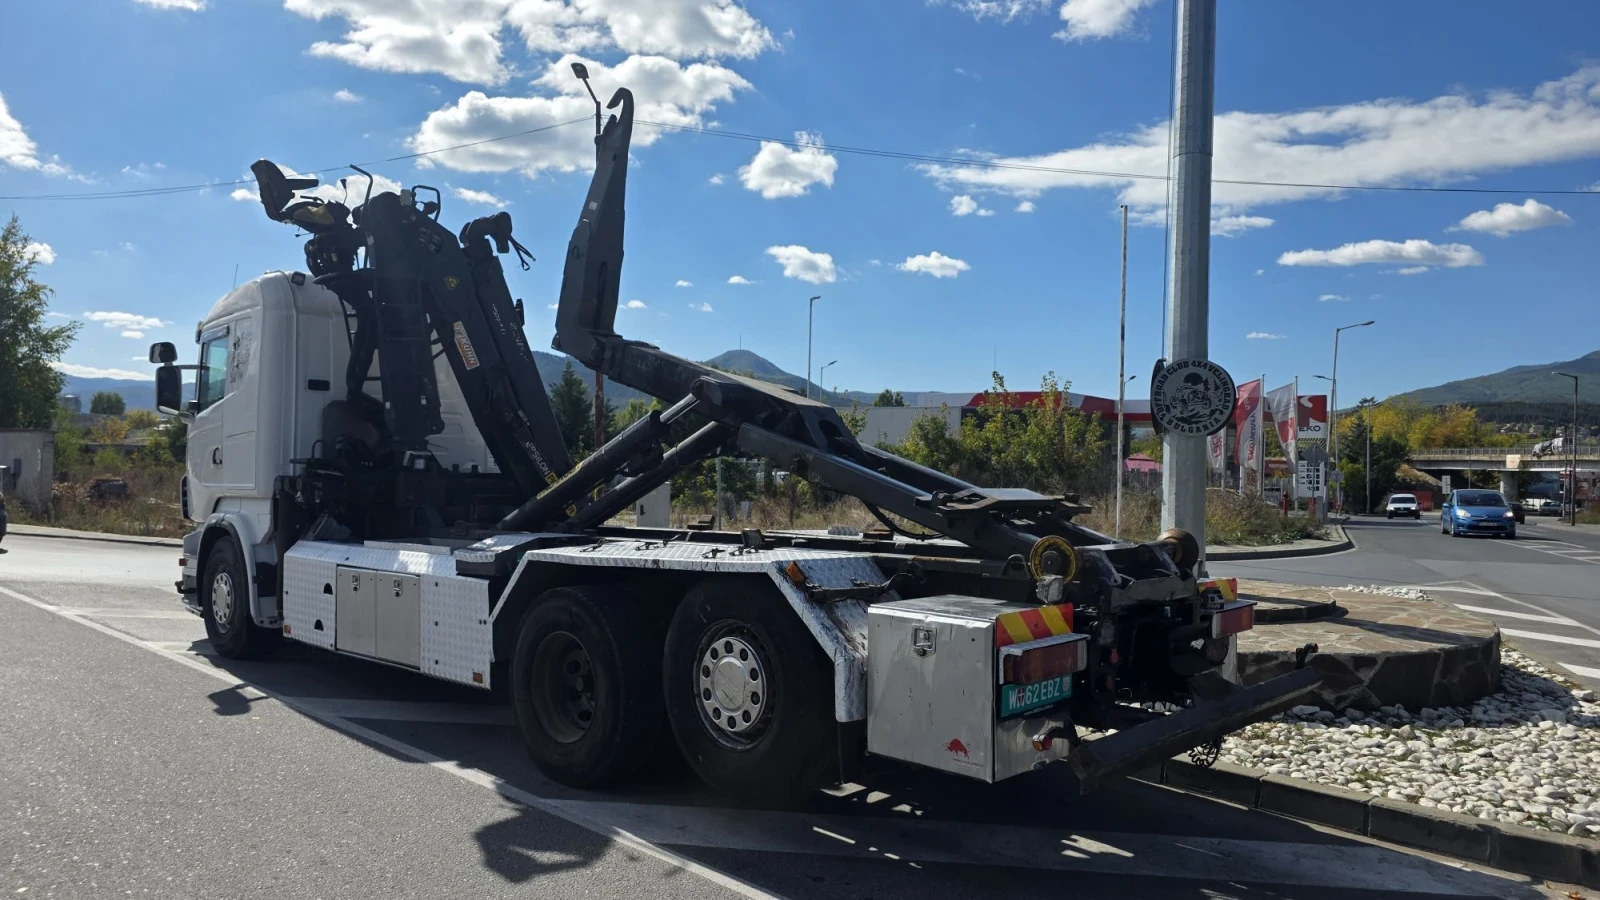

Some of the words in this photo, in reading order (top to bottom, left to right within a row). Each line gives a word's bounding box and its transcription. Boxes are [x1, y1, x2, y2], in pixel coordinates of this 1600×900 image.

[460, 338, 476, 364] KUHN
[1155, 374, 1169, 413] OFFROAD
[1167, 361, 1190, 375] CLUB
[1208, 366, 1231, 411] VELINGRAD
[1166, 417, 1221, 434] BULGARIA
[526, 441, 551, 475] EPSILON
